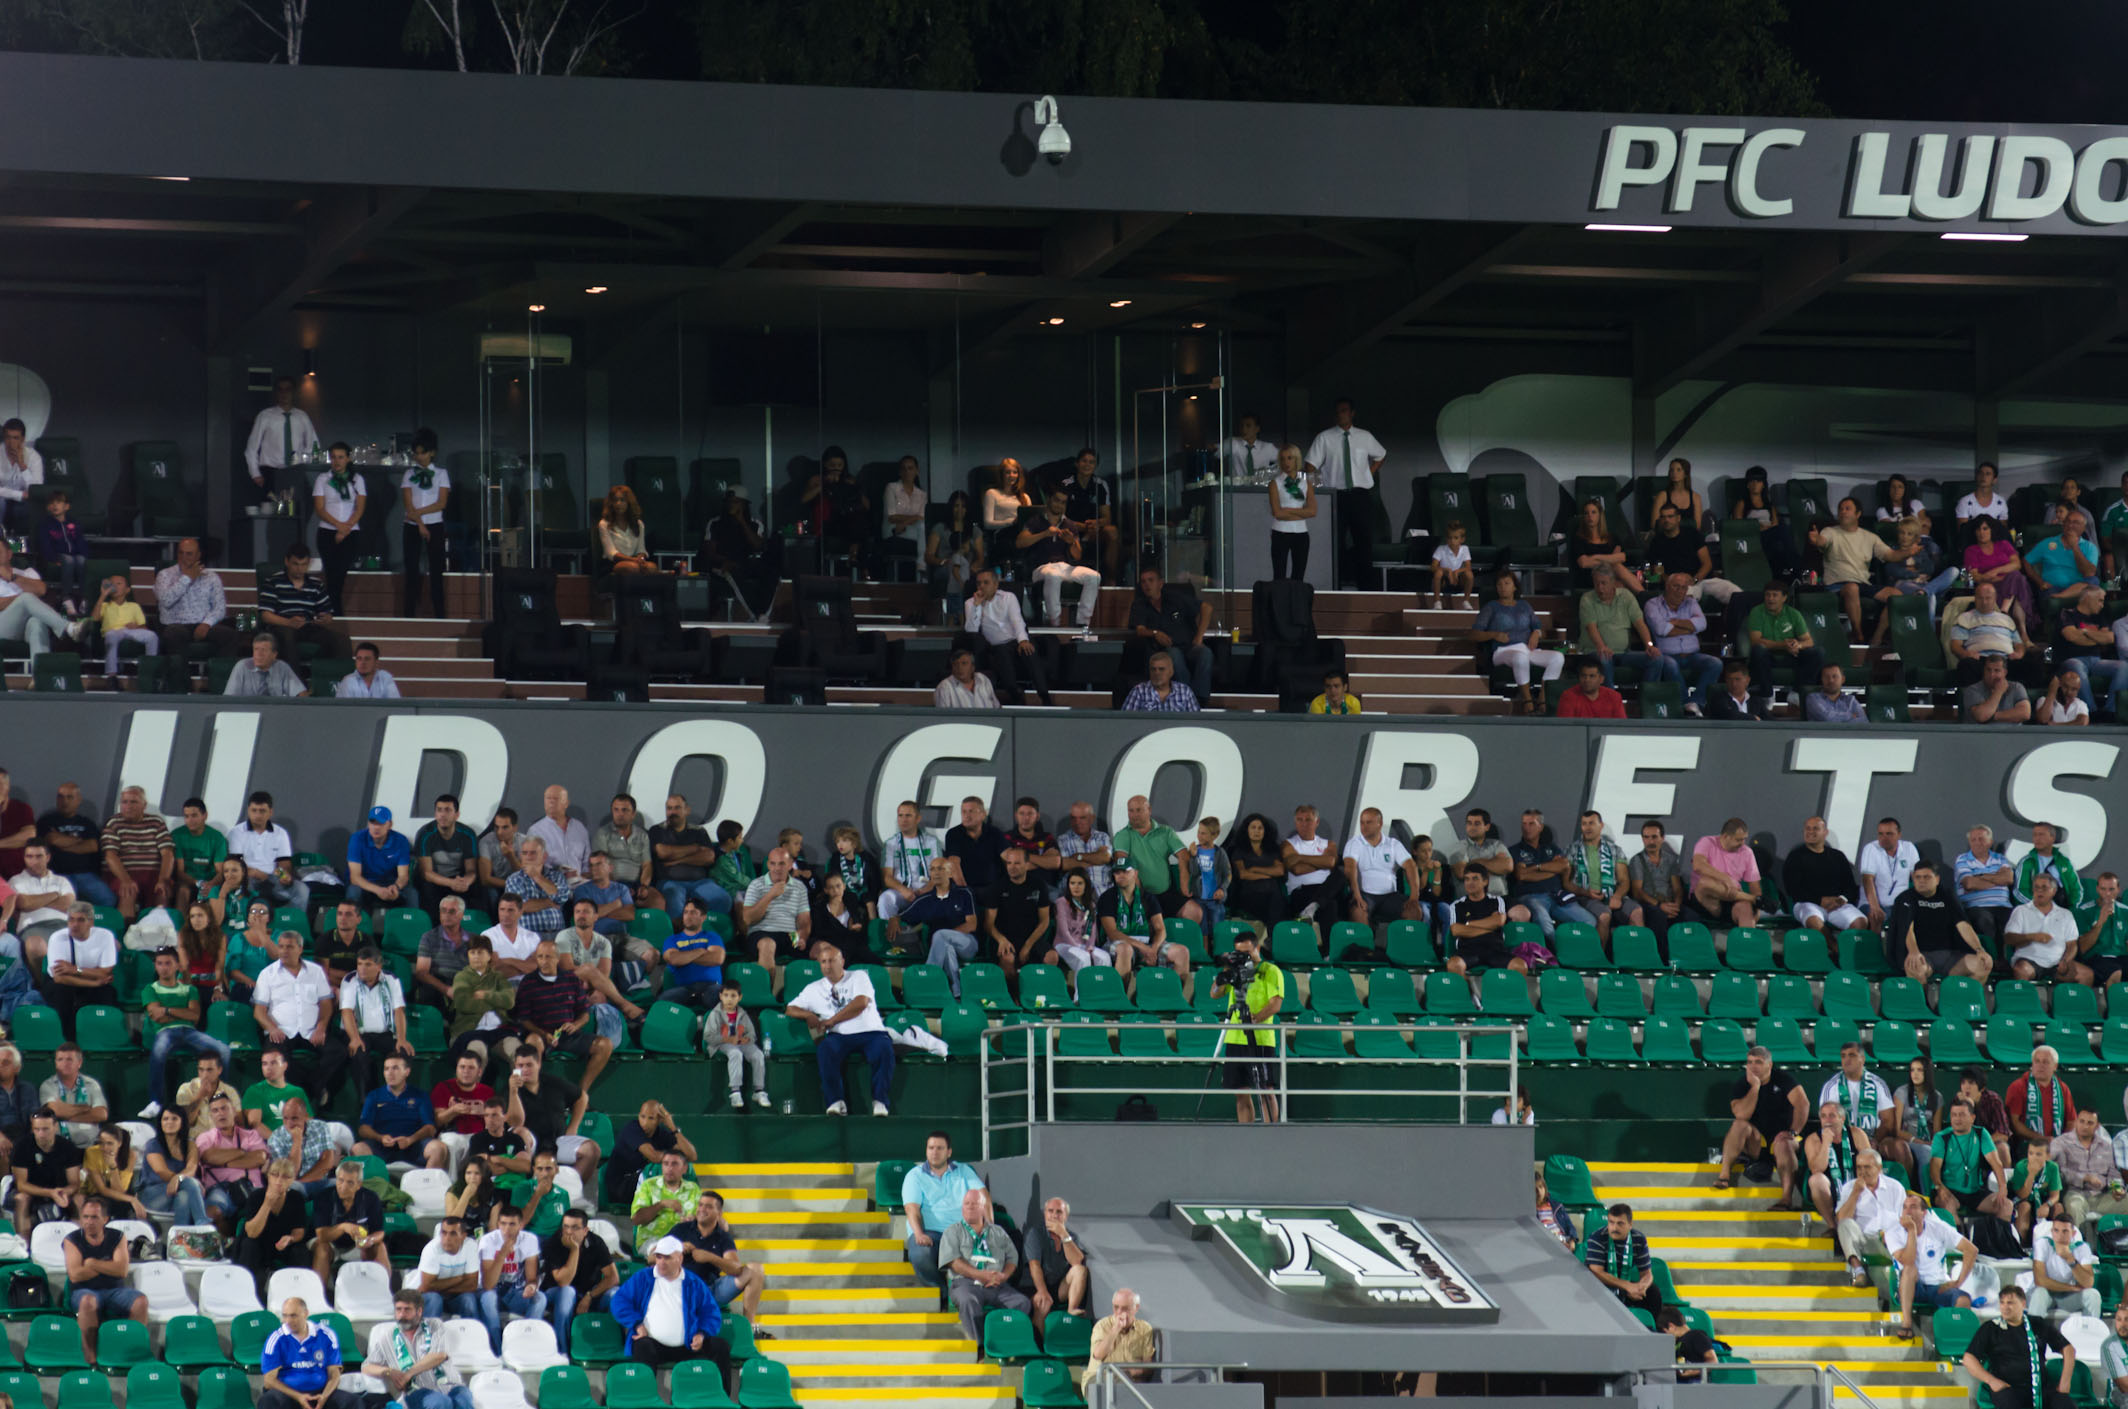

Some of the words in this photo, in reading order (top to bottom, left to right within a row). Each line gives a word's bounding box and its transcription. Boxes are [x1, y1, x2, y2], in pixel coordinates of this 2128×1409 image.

[1595, 124, 1806, 217] PFC
[1848, 131, 2128, 224] LUDO
[1203, 1208, 1262, 1222] PFC
